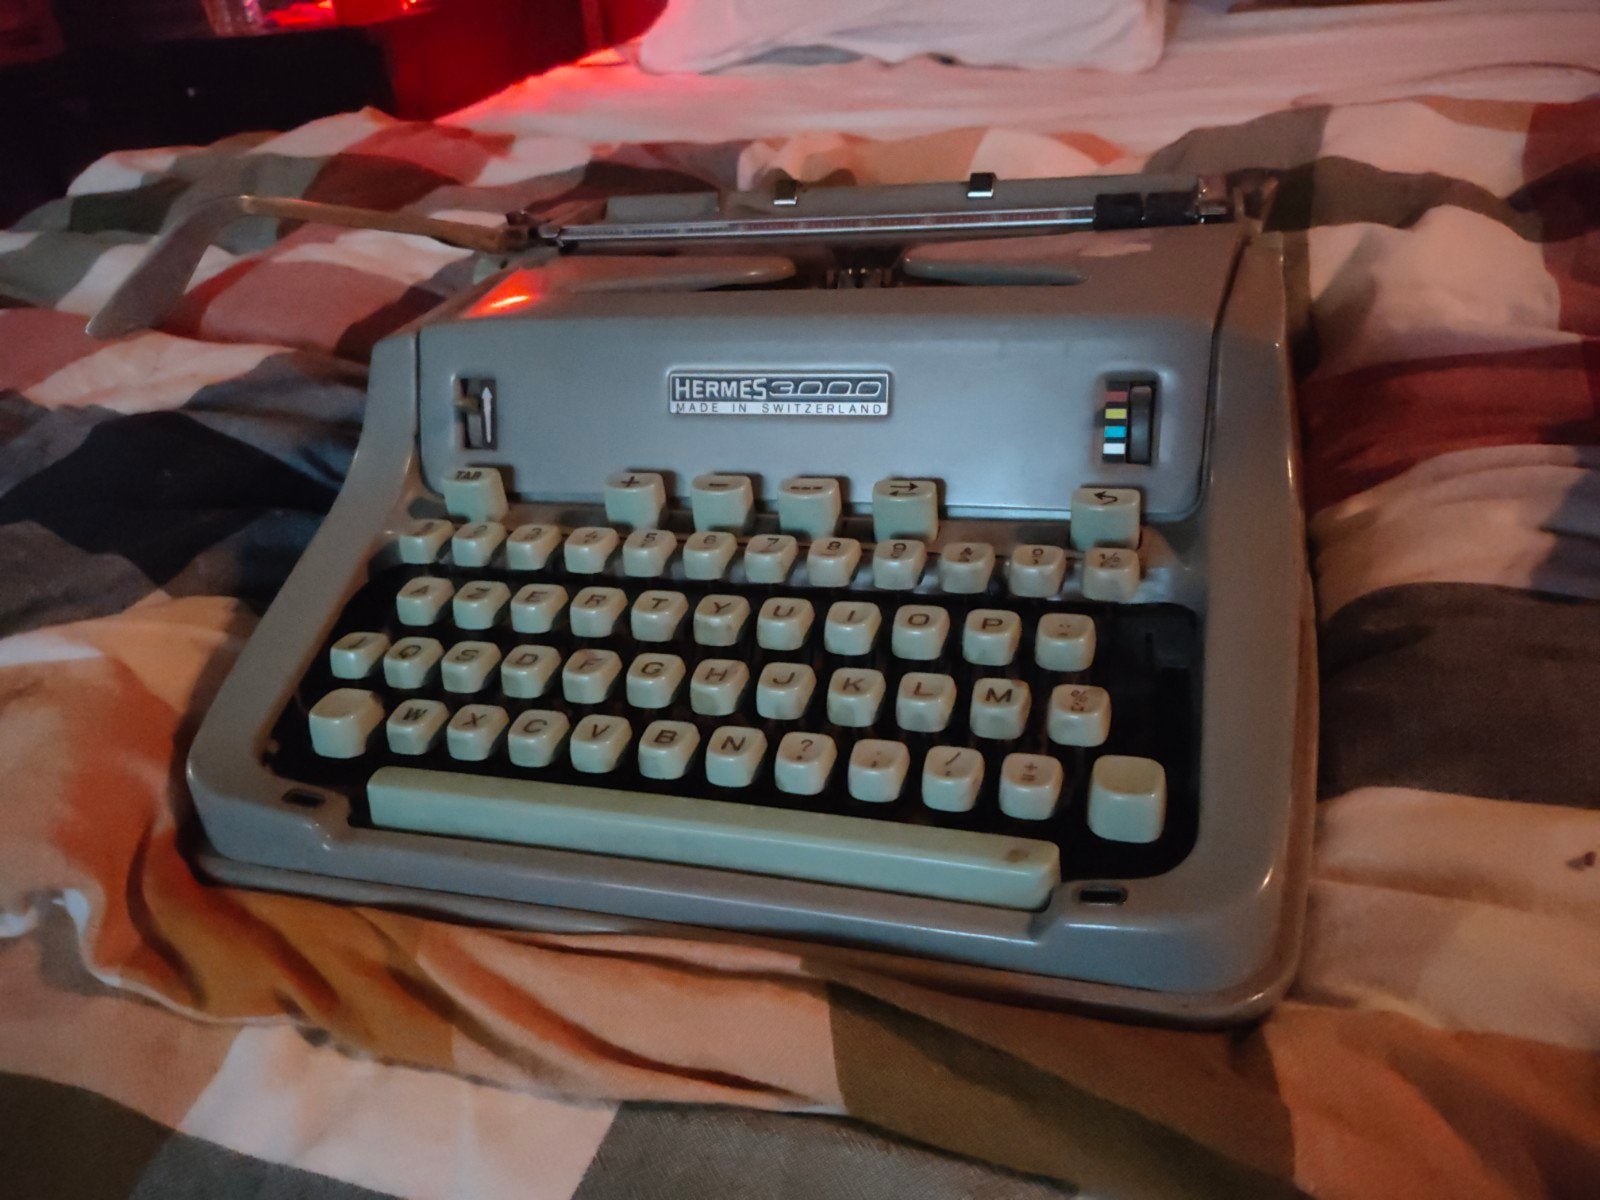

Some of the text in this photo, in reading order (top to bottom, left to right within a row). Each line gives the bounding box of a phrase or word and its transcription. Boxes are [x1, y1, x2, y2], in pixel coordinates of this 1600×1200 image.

[675, 378, 882, 400] HERMES 3000
[676, 403, 882, 414] MADE IN SWITZERLAND
[767, 537, 780, 547] 7
[585, 594, 607, 605] R
[652, 598, 669, 609] T
[713, 602, 731, 613] Y
[773, 605, 795, 618] U
[908, 613, 929, 625] O
[982, 617, 1003, 630] P
[454, 649, 479, 662] S
[513, 653, 538, 666] D
[578, 657, 603, 670] F
[641, 661, 664, 676] G
[704, 667, 728, 682] H
[772, 672, 796, 685] J
[843, 677, 864, 692] K
[913, 681, 934, 696] L
[986, 687, 1013, 703] M
[402, 707, 427, 721] W
[462, 712, 487, 728] X
[523, 718, 548, 734] C
[591, 724, 611, 739] V
[653, 729, 678, 744] B
[720, 735, 747, 751] N
